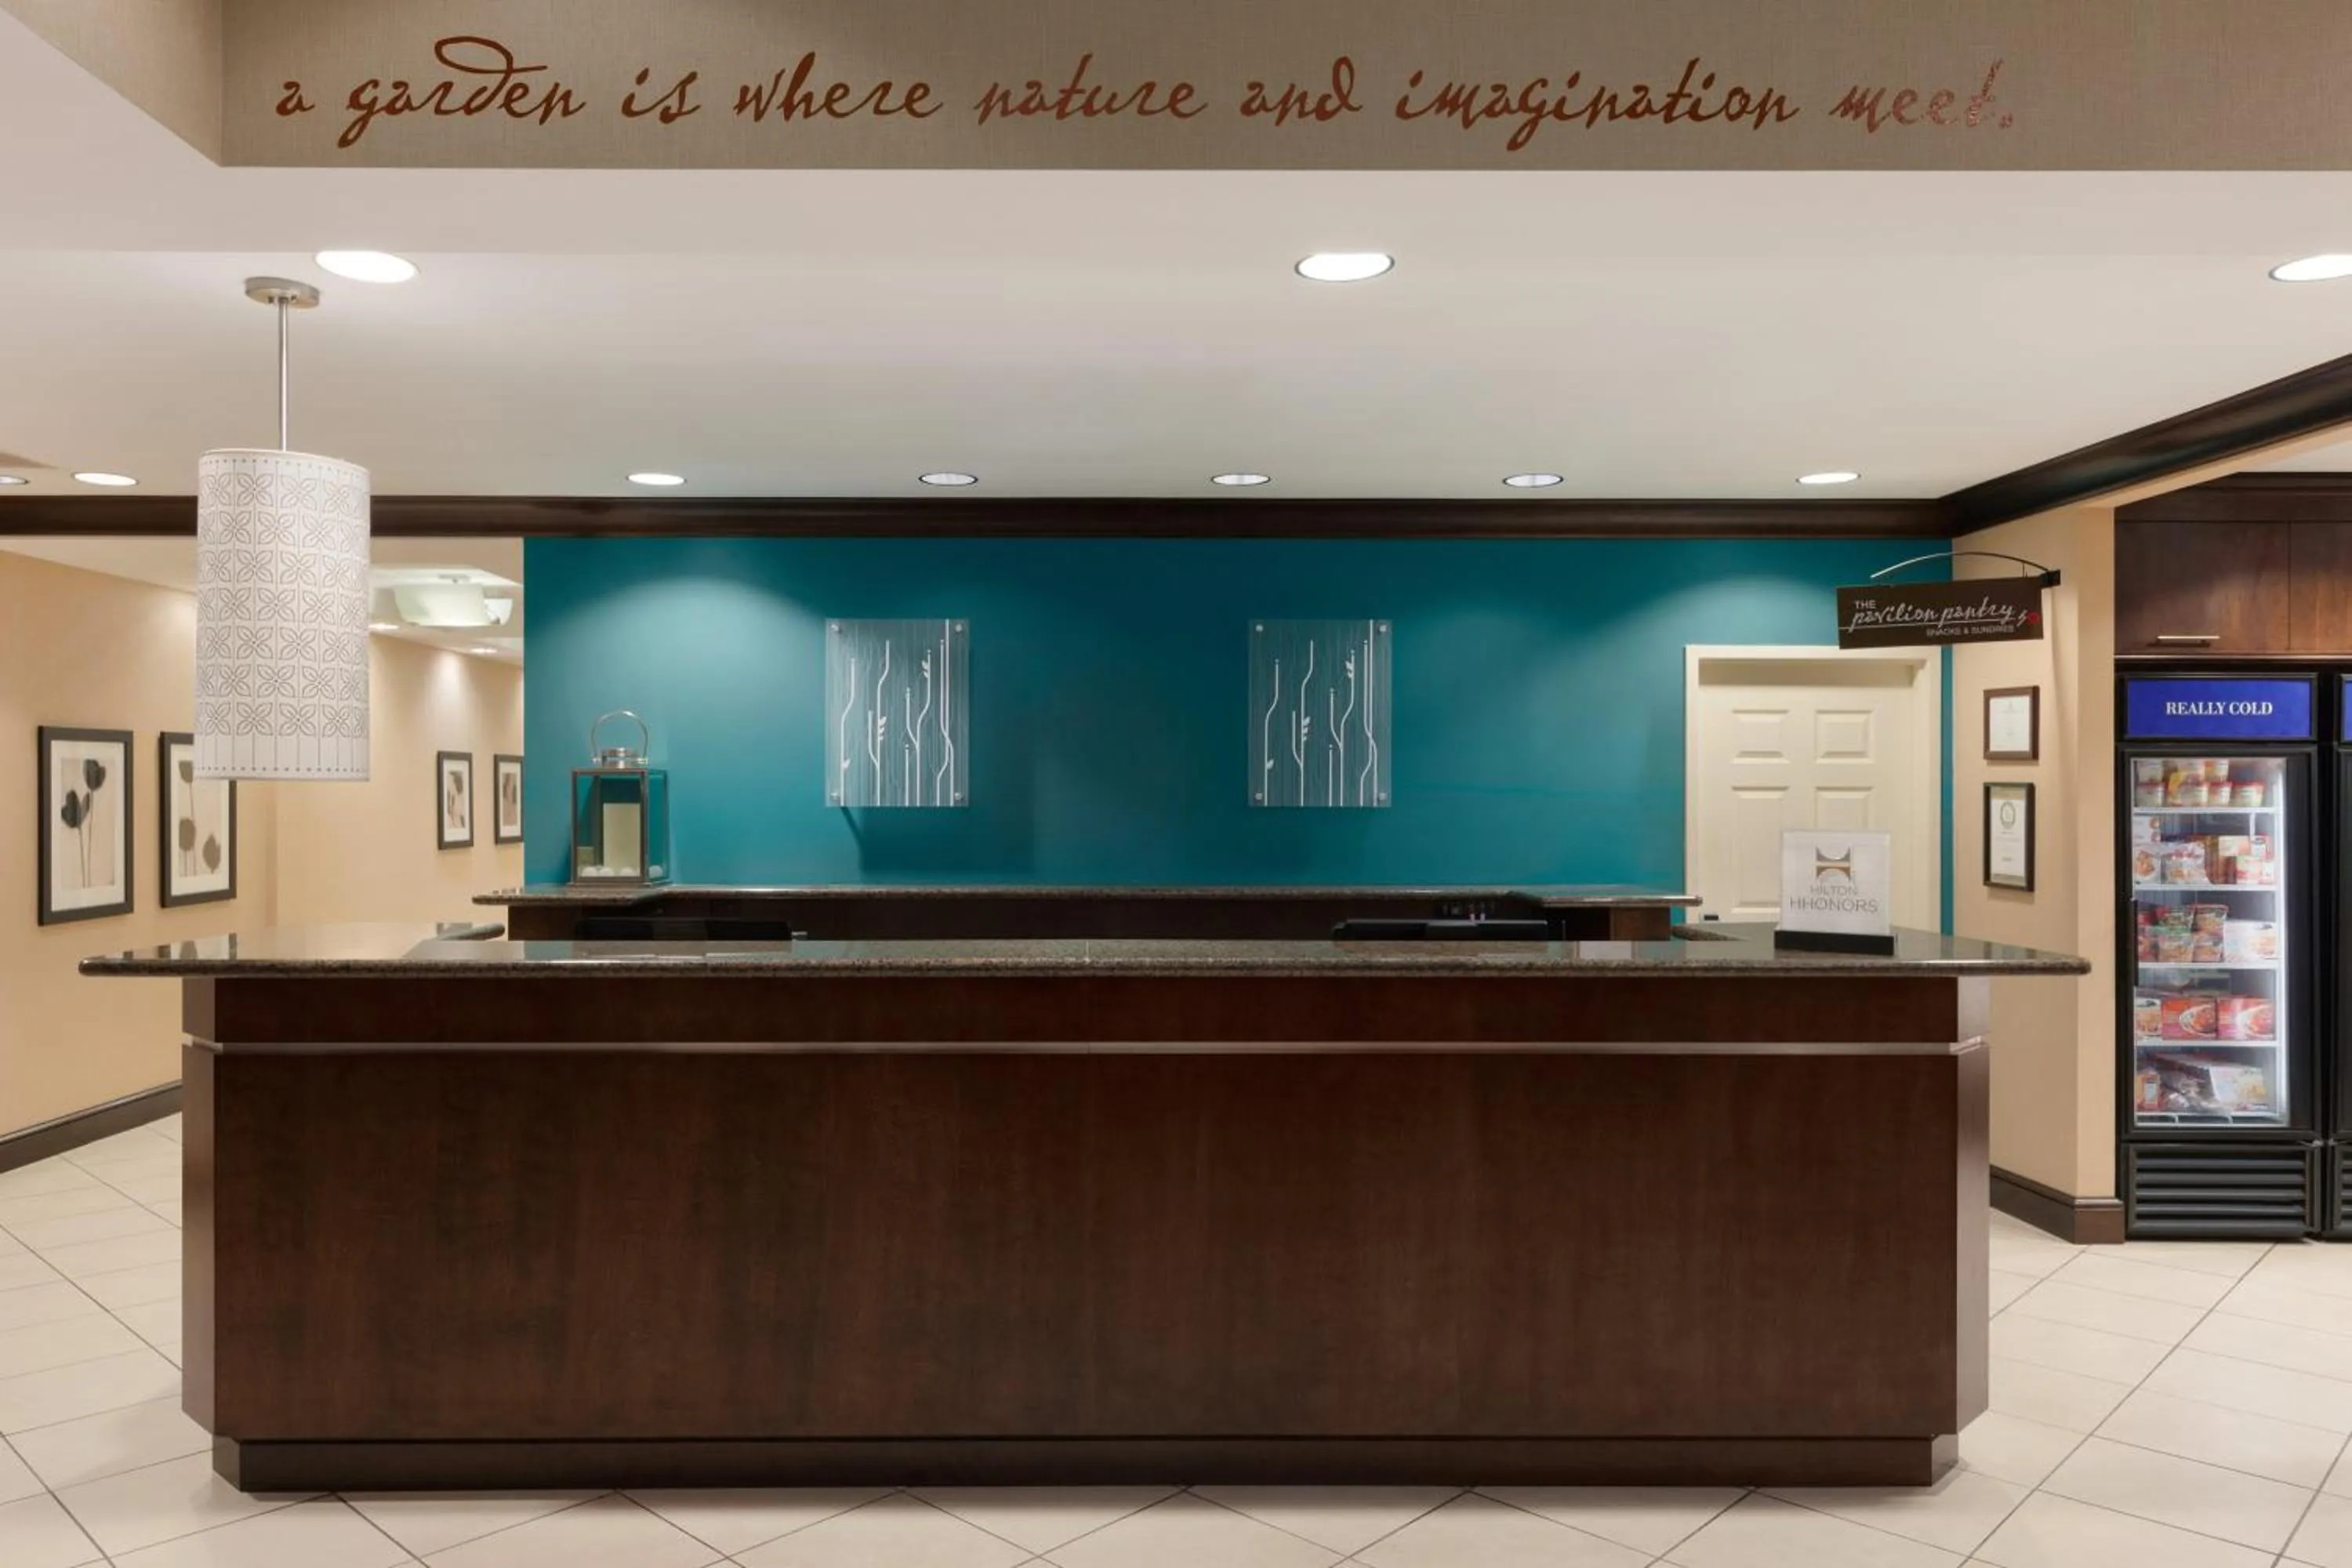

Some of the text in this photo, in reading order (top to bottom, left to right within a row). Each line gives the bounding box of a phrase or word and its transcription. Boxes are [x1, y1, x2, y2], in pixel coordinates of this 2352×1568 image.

[276, 35, 2014, 152] a garden is where nature and imagination meet.
[1855, 600, 1876, 610] THE
[1847, 596, 2016, 633] pavilion pantry
[2165, 701, 2274, 716] REALLY COLD
[1809, 884, 1858, 896] HILTON
[1790, 895, 1878, 913] HHONORS
